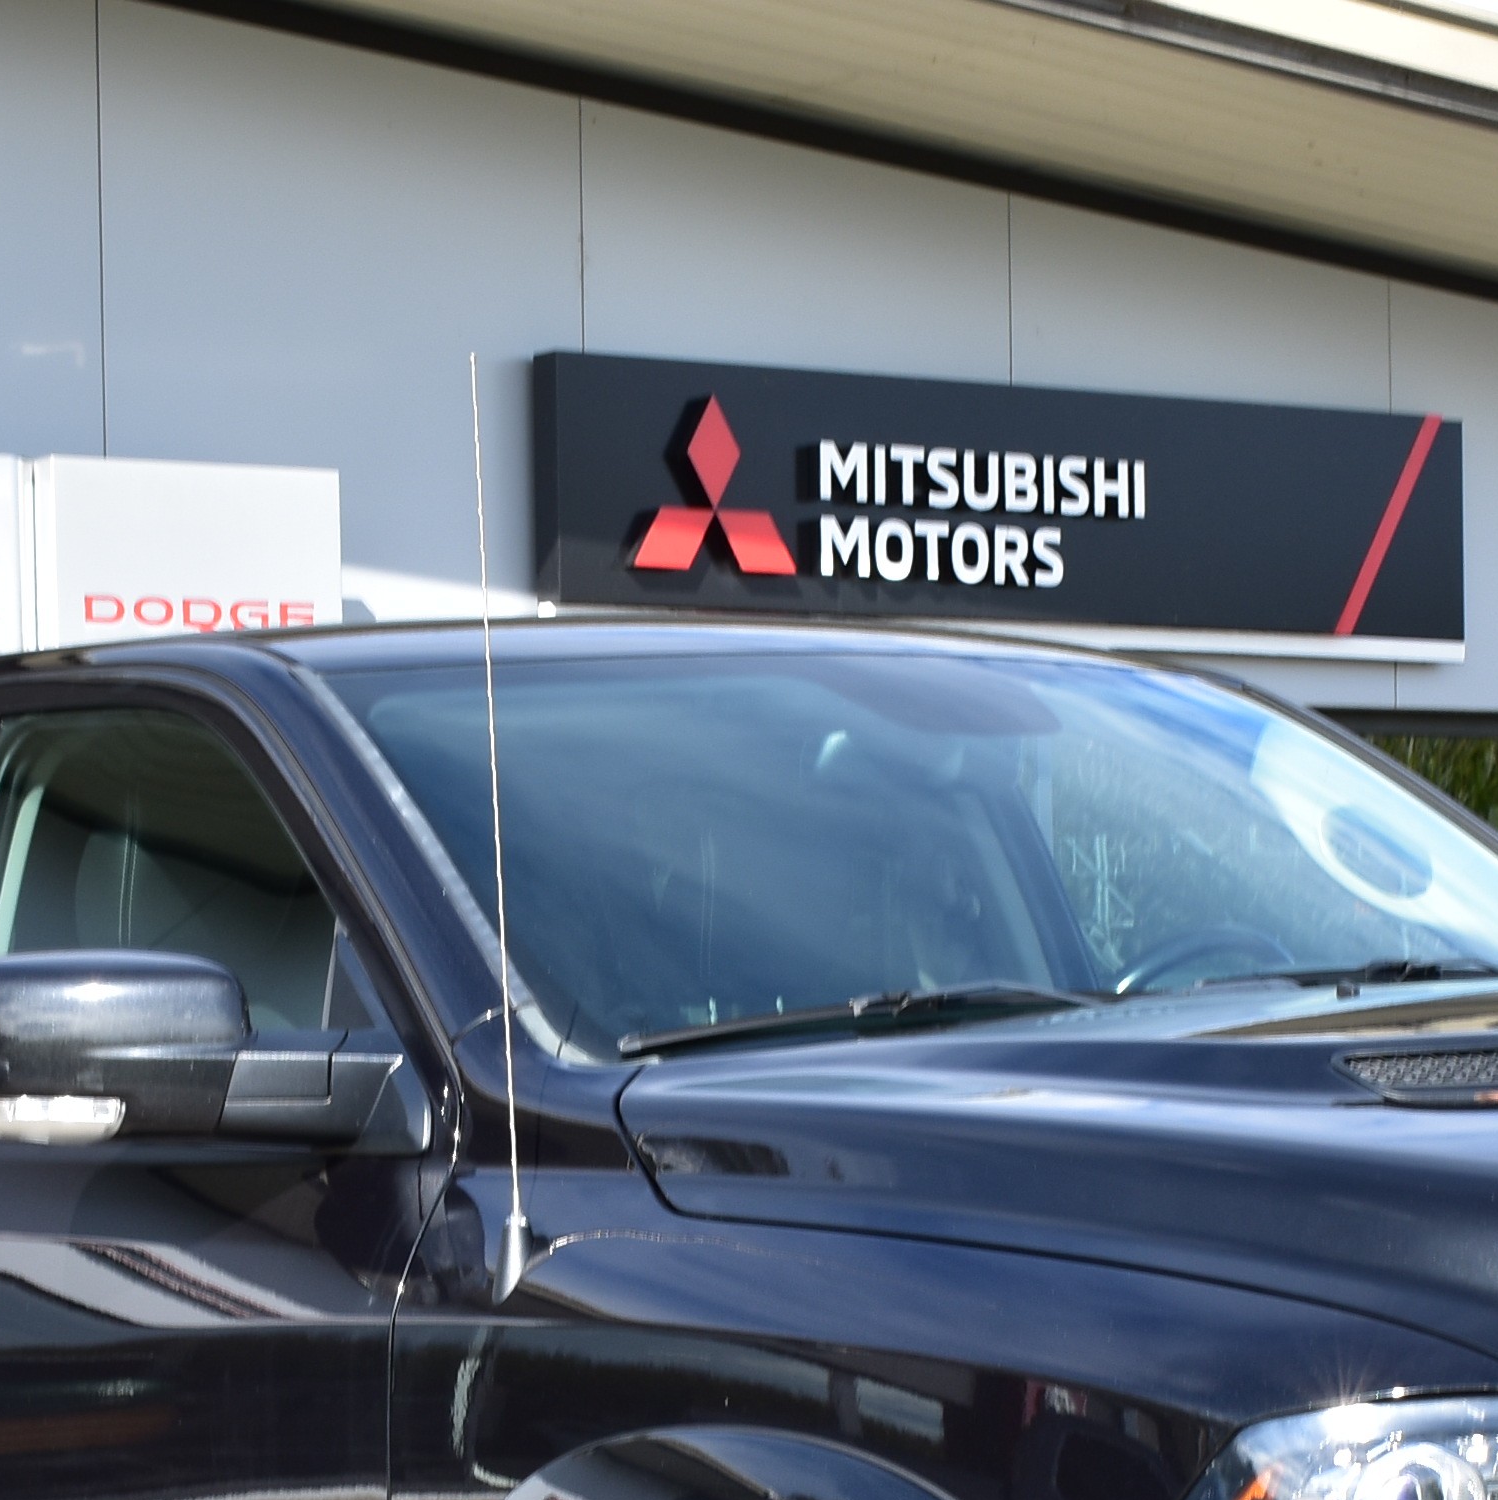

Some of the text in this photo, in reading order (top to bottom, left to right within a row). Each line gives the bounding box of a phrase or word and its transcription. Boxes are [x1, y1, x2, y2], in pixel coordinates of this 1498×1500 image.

[818, 439, 1146, 520] MITSUBISHI
[818, 513, 1064, 588] MOTORS
[84, 593, 315, 633] DODGE
